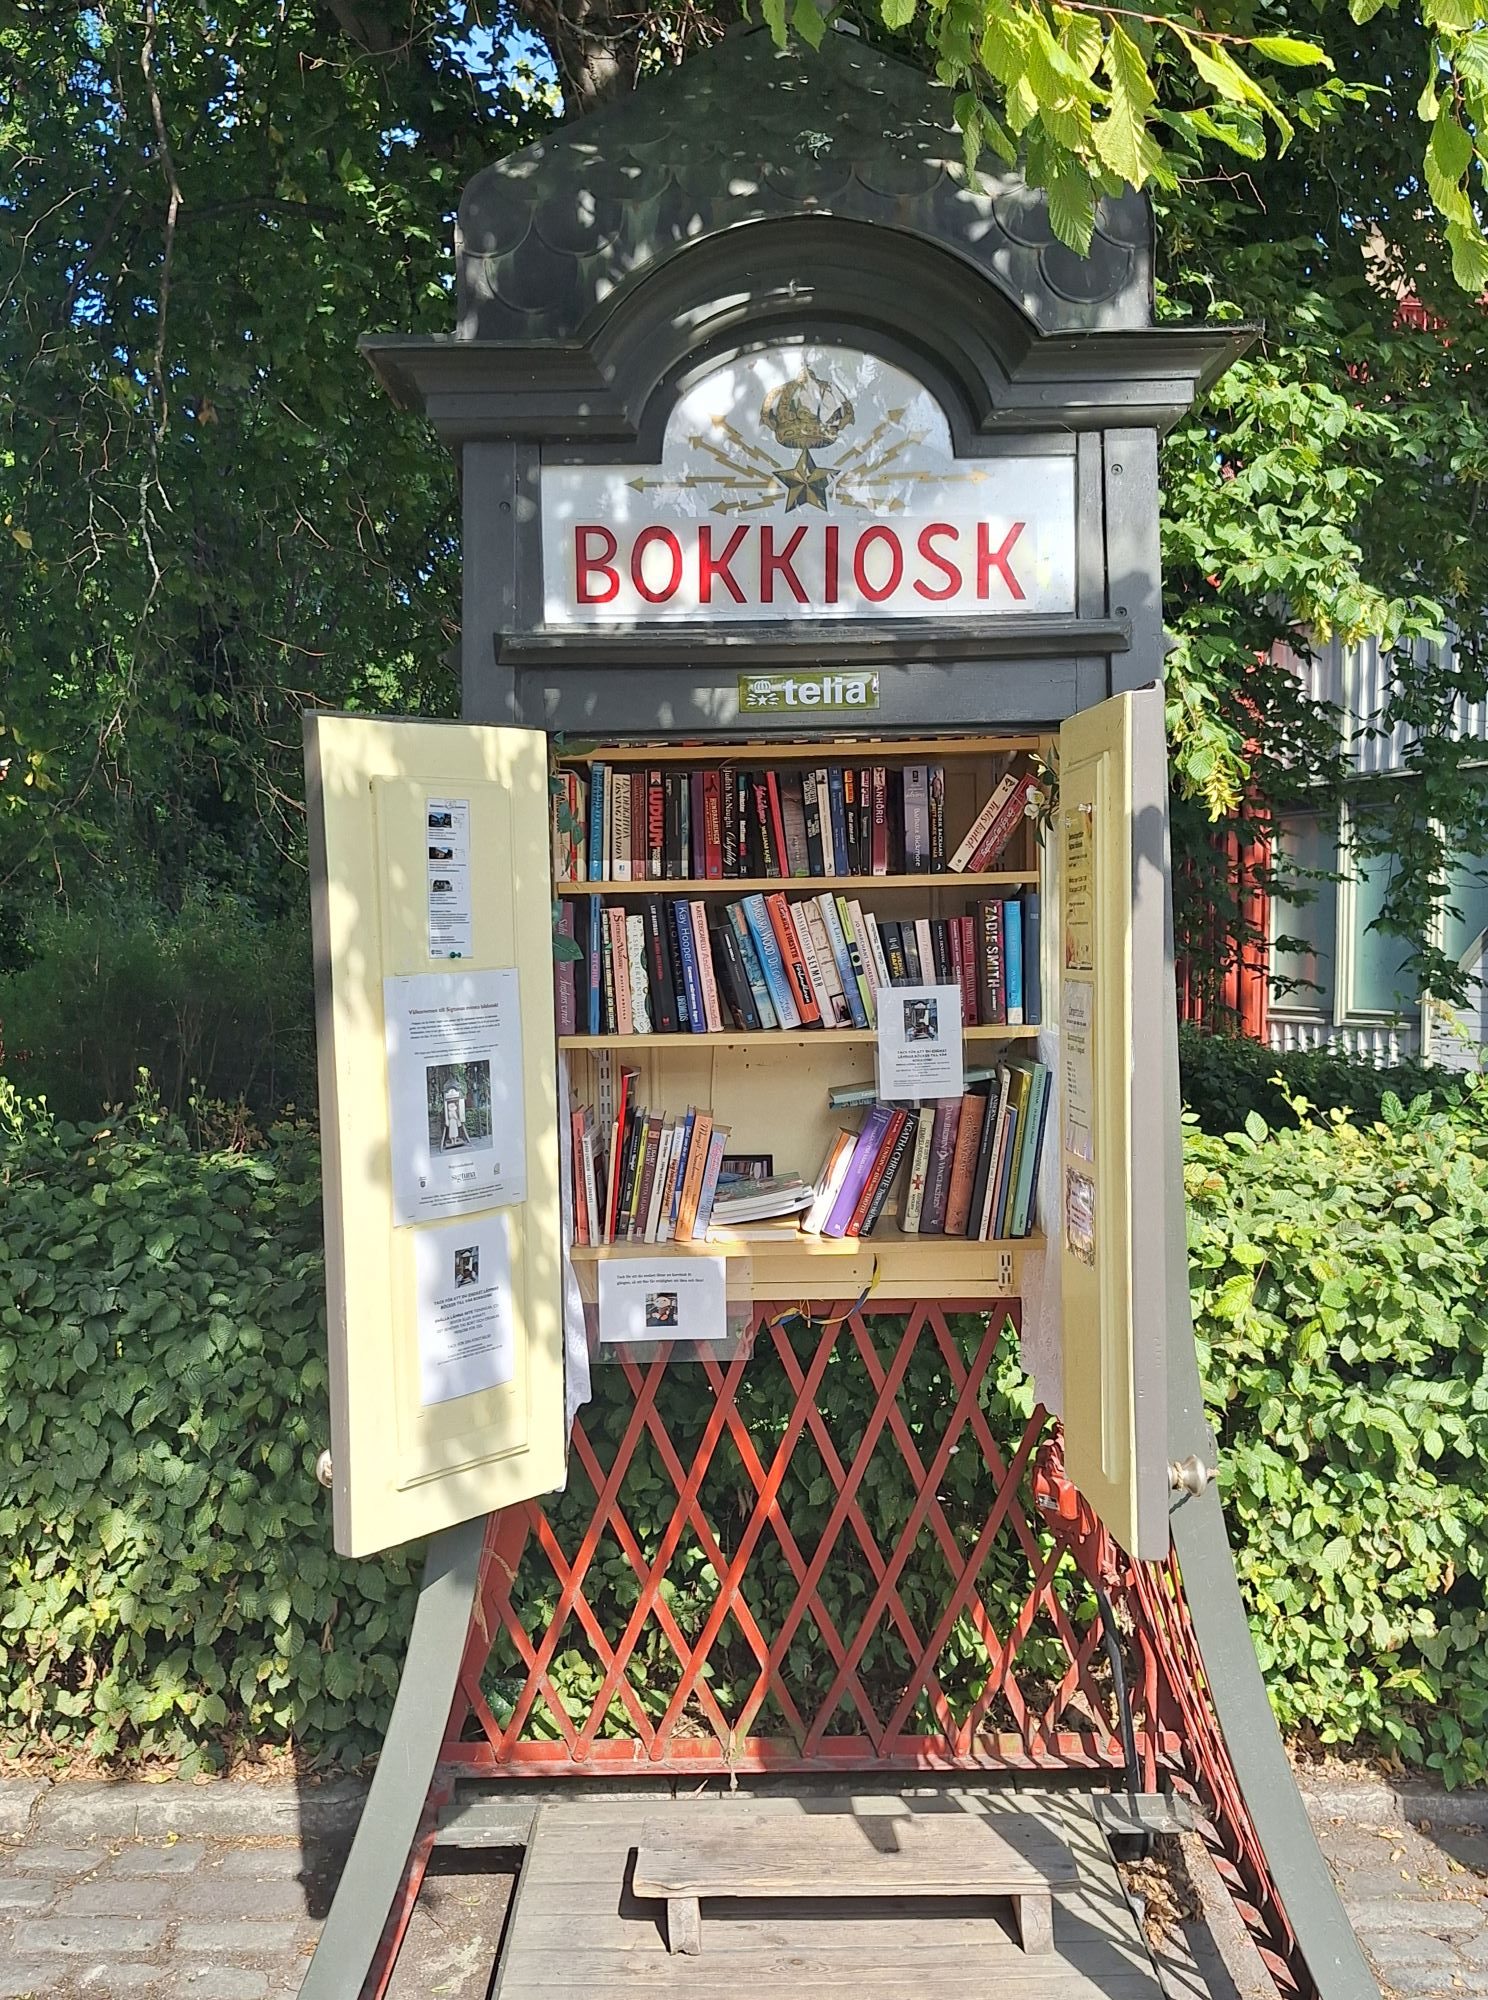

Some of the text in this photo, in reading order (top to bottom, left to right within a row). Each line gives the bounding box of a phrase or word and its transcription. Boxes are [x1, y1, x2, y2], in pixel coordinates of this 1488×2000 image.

[574, 523, 1026, 604] BOKKIOSK
[782, 675, 867, 706] telia
[649, 787, 663, 846] LUDLUM
[723, 769, 737, 866] Judith McNaught Oskyldig
[875, 785, 884, 824] ANHÖRIG
[913, 808, 921, 833] Barbara
[760, 826, 769, 848] WILLIAM
[678, 907, 688, 924] Kay
[696, 906, 704, 919] KATE
[752, 898, 769, 931] BARBARA
[761, 931, 776, 955] WOOD
[984, 906, 998, 943] ZADIE
[681, 928, 693, 963] Hooper
[785, 933, 798, 959] FORSYTH
[856, 928, 868, 959] MARCHANT
[807, 955, 822, 988] SEYMOR
[985, 946, 1000, 988] SMITH
[943, 1105, 953, 1121] DAN
[694, 1123, 707, 1149] Margit
[894, 1118, 915, 1151] AGATHA
[939, 1123, 951, 1150] BROWN
[691, 1149, 703, 1181] Sandemo
[878, 1146, 890, 1166] UNION
[880, 1149, 902, 1188] CHRISTIE
[859, 1193, 872, 1214] THOTH
